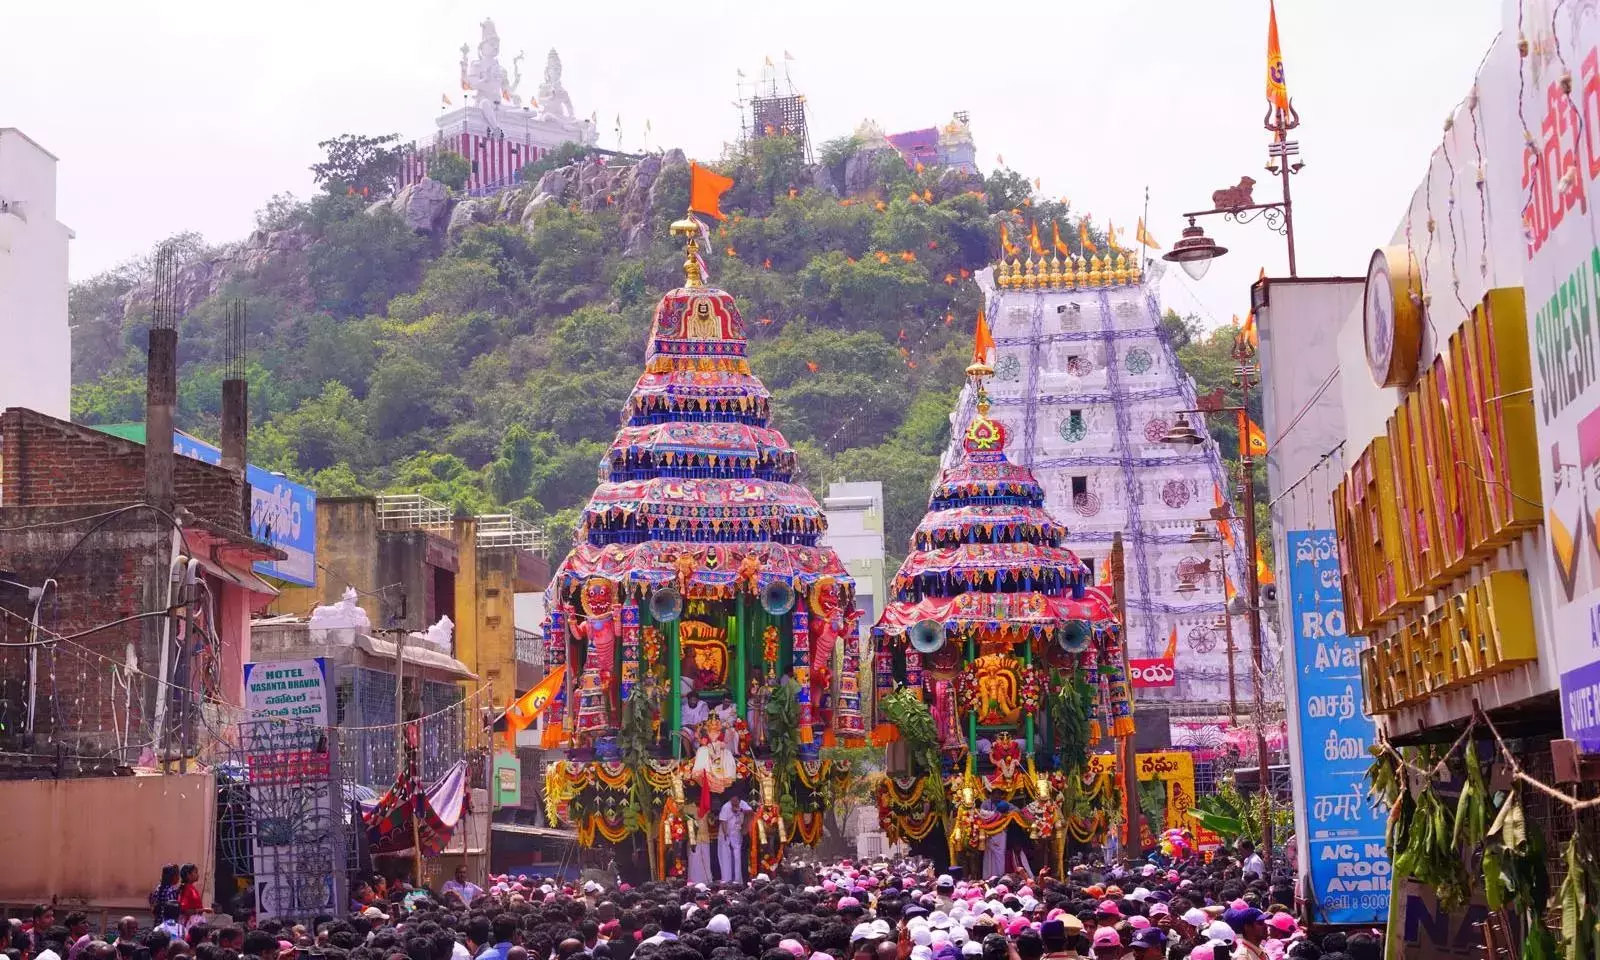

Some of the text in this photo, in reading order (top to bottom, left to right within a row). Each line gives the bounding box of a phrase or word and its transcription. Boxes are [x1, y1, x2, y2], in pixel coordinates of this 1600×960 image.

[1535, 260, 1596, 427] SURESH
[265, 668, 304, 680] HOTEL
[250, 679, 320, 692] VASANTA BHAVAN
[1308, 684, 1355, 726] வசதி
[1569, 684, 1594, 731] SUITE
[1142, 756, 1179, 773] నమః
[1321, 844, 1359, 861] A/C,
